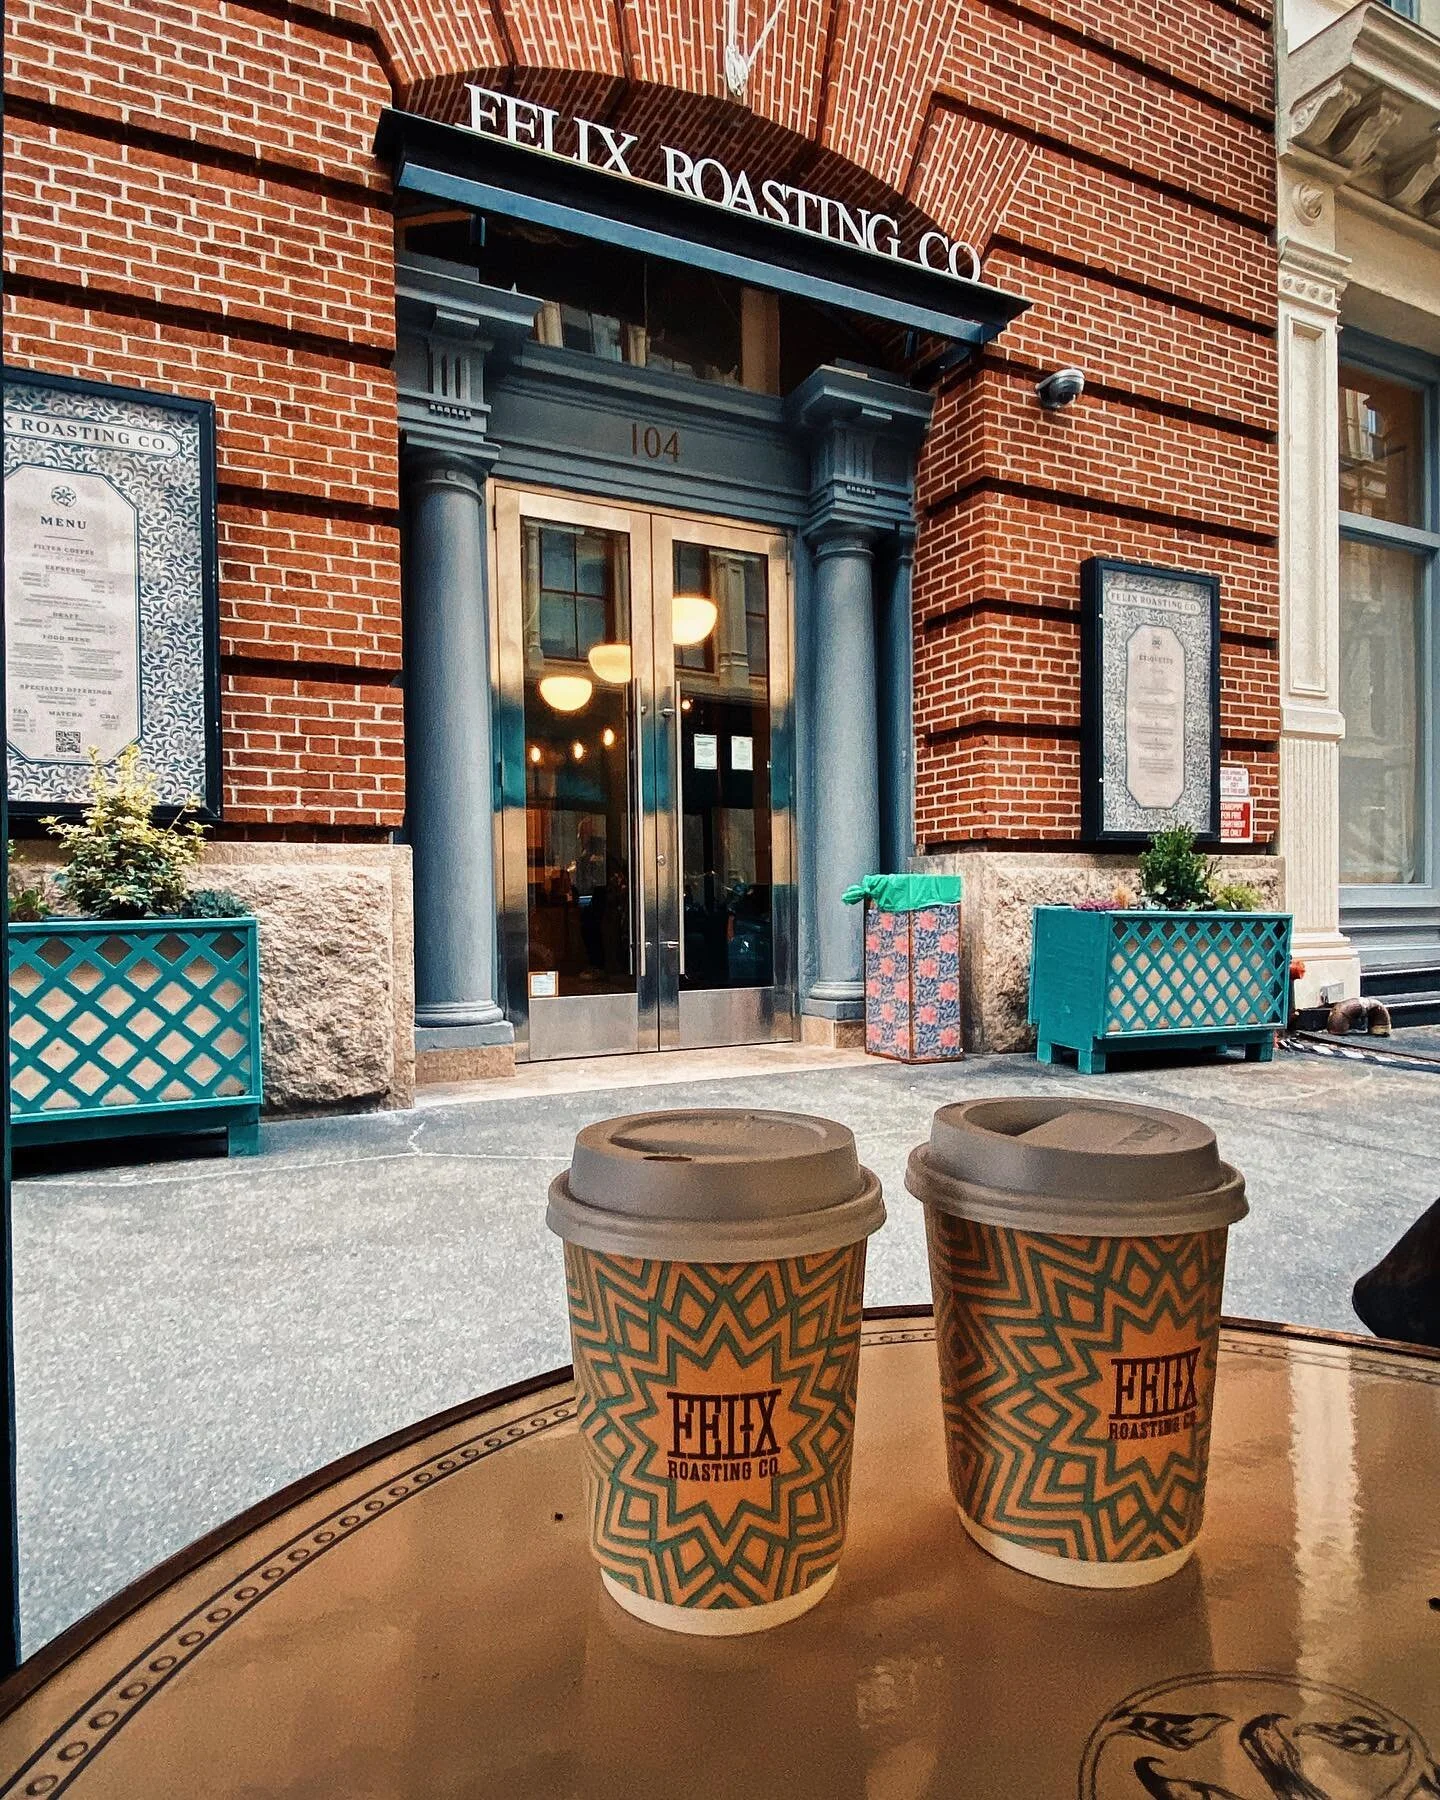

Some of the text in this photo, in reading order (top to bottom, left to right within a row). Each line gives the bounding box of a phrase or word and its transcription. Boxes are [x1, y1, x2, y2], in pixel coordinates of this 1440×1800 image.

[454, 83, 981, 283] FELIX ROASTING CO
[21, 418, 130, 445] ROASTING
[138, 436, 172, 451] CO.
[632, 422, 680, 462] 104
[40, 515, 87, 530] MENU
[1111, 592, 1138, 603] FELIX
[1140, 595, 1182, 609] ROASTING
[1109, 1346, 1201, 1421] FELIX
[667, 1389, 781, 1460] FELIX
[1109, 1417, 1180, 1441] ROASTING
[668, 1459, 752, 1482] ROASTING
